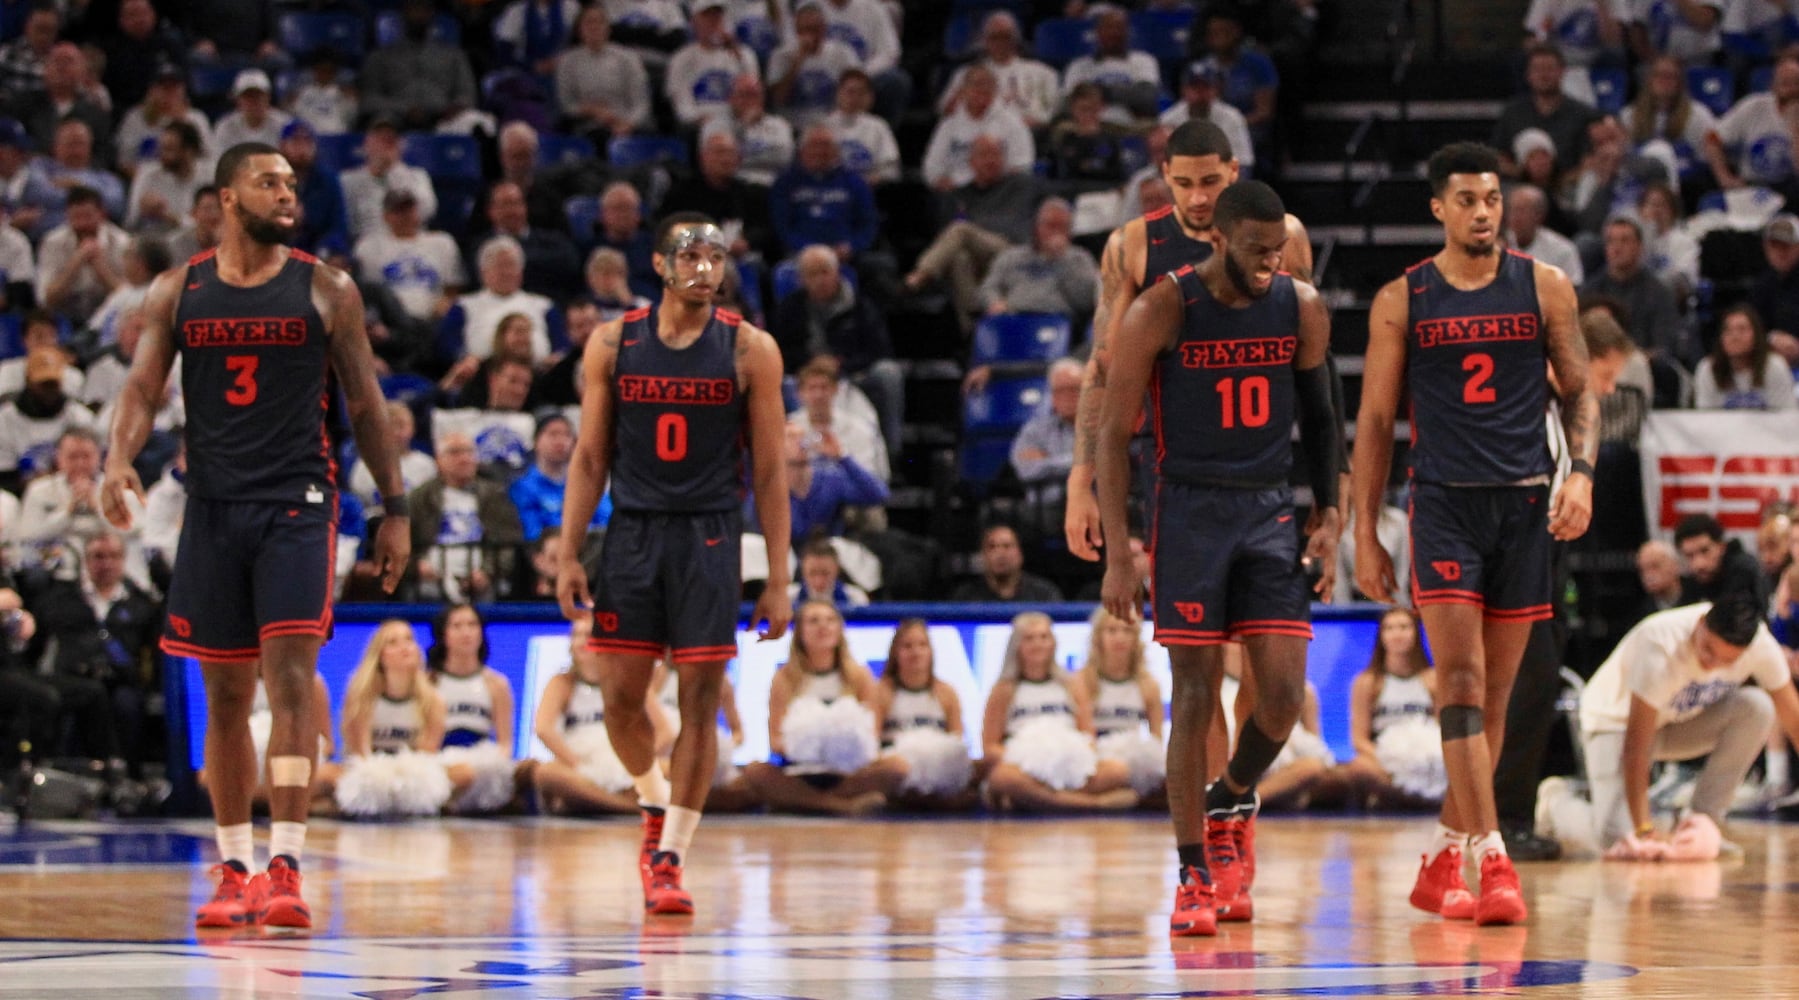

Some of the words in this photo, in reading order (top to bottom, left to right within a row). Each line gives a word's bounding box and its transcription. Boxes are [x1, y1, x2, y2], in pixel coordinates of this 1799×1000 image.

[184, 318, 307, 347] FLYERS
[1415, 313, 1538, 348] FLYERS
[1180, 336, 1297, 368] FLYERS
[225, 355, 259, 406] 3
[619, 374, 734, 404] FLYERS
[1462, 353, 1496, 404] 2
[1215, 375, 1270, 429] 10
[656, 412, 688, 462] 0
